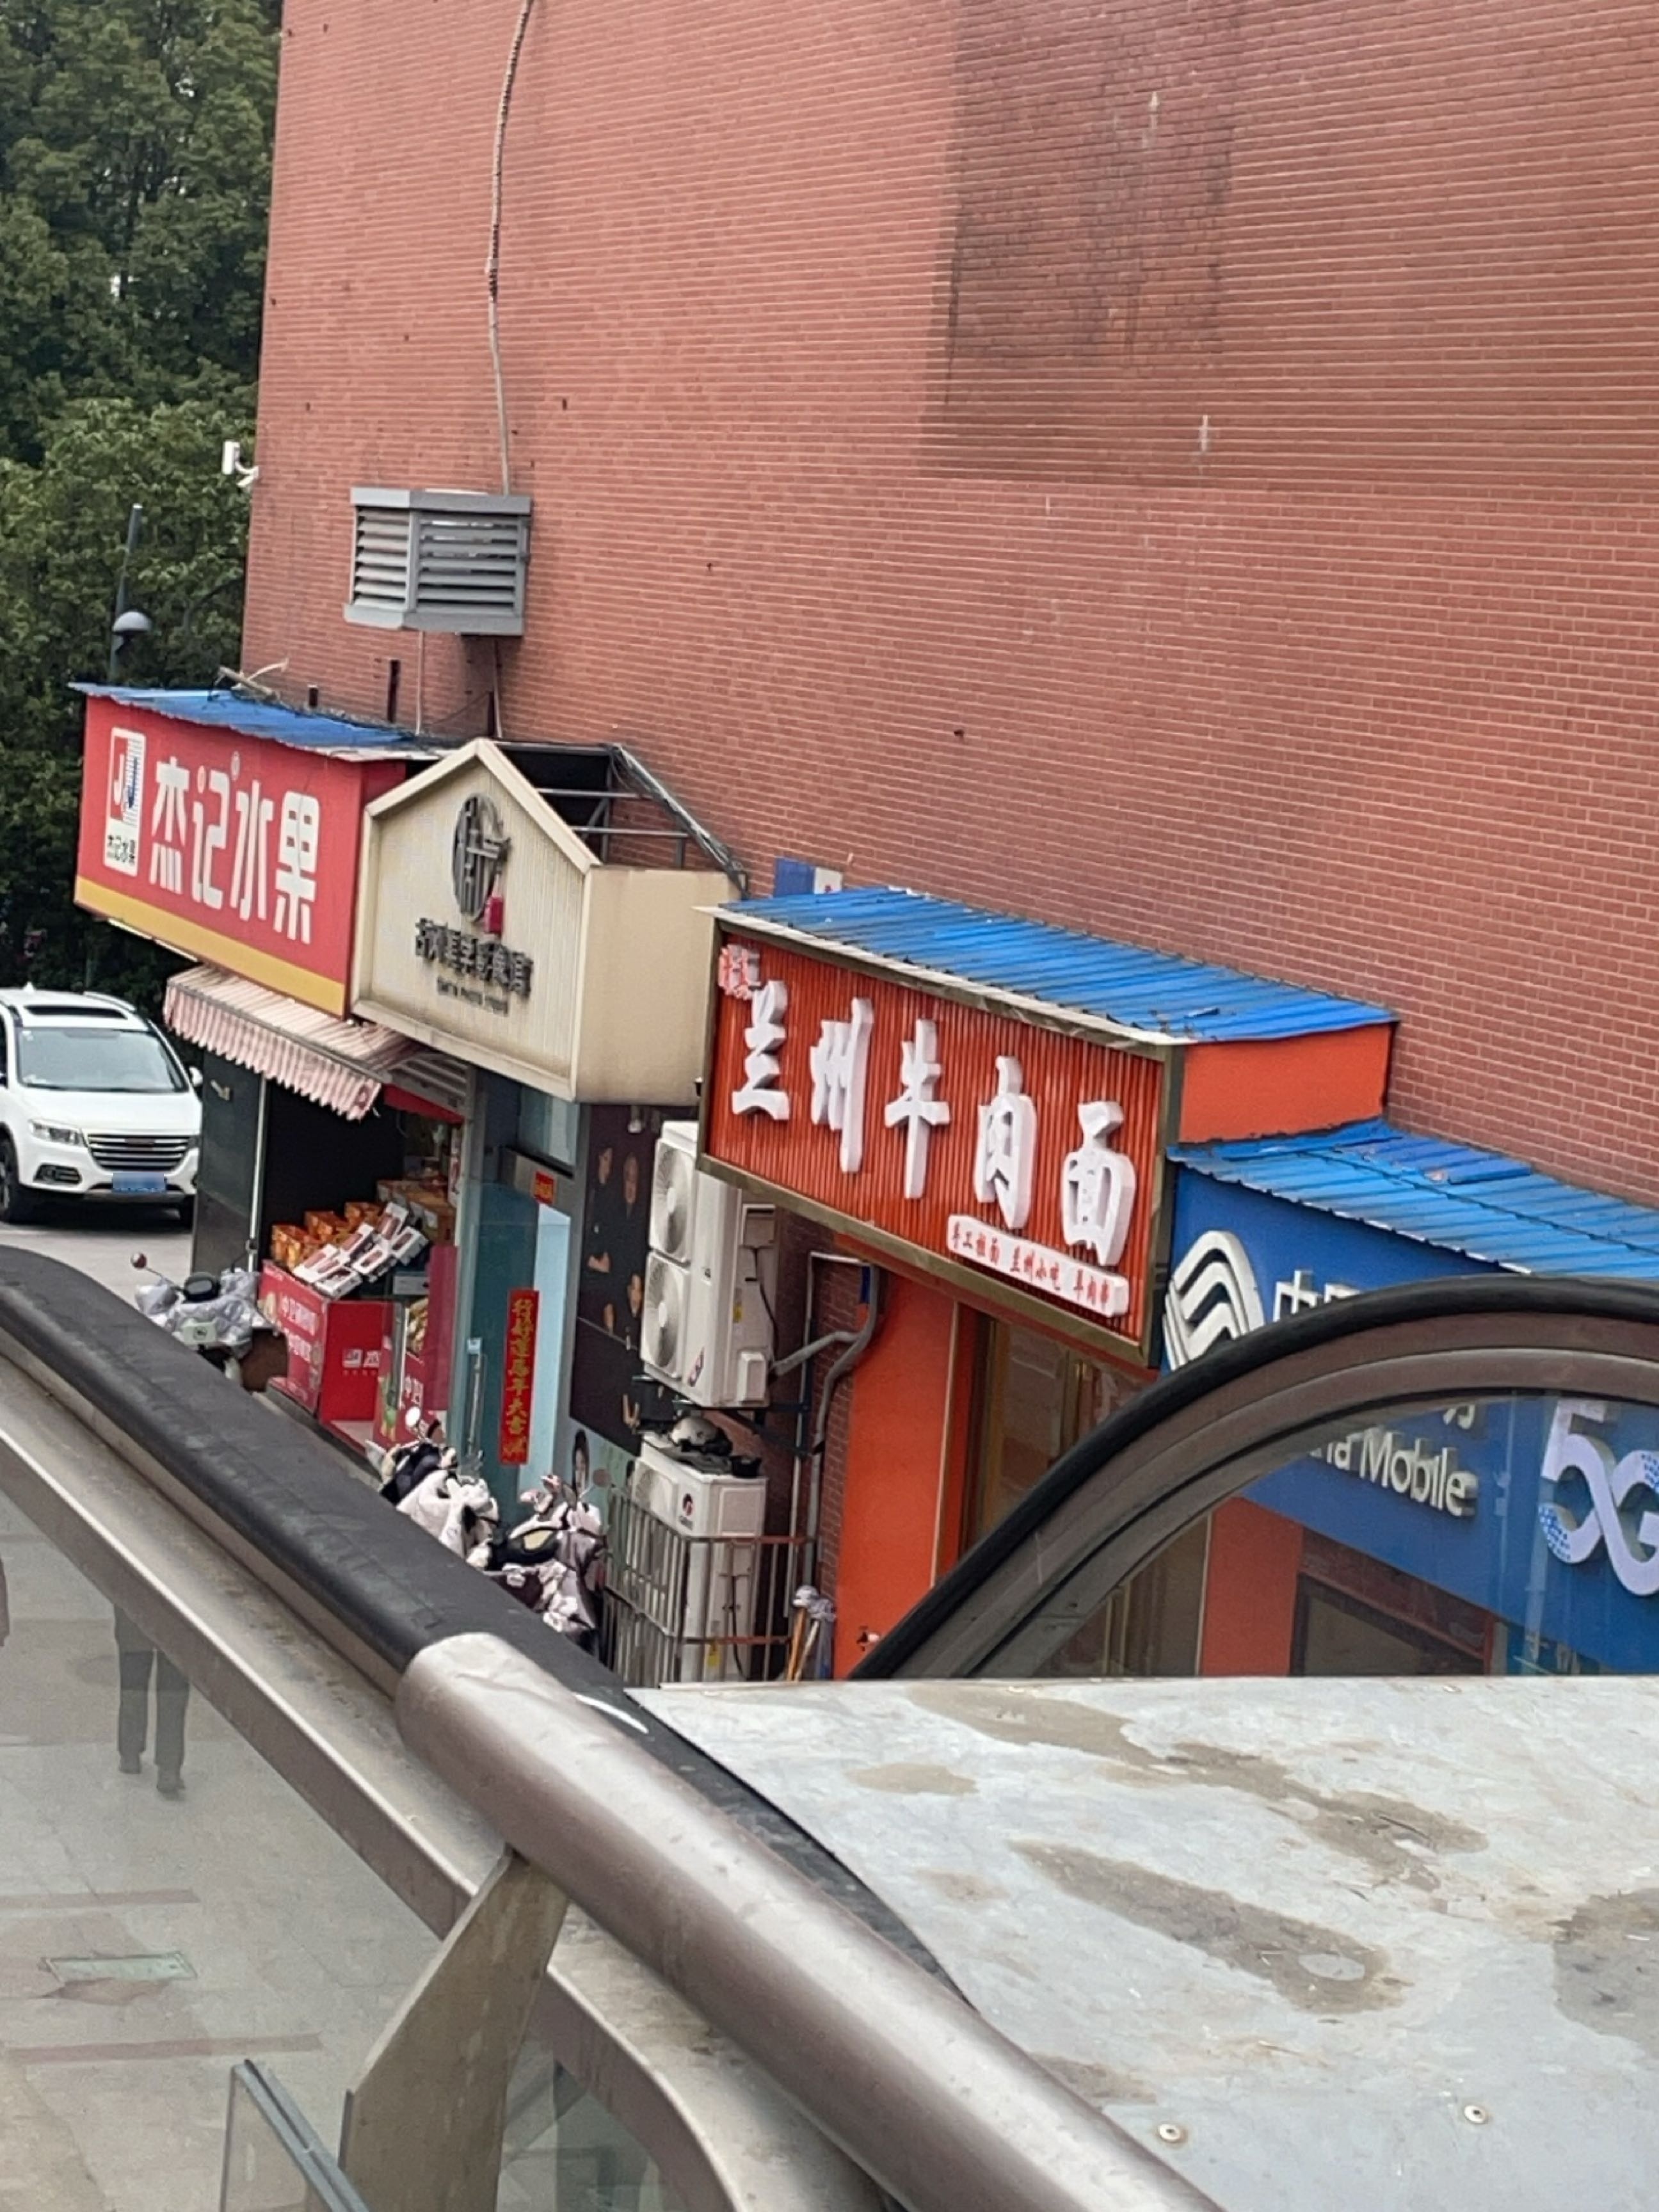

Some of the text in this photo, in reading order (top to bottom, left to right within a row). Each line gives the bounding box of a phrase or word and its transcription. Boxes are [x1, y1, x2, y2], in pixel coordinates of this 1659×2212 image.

[150, 755, 319, 945] 杰记水果
[732, 980, 1135, 1265] 兰州牛肉面
[1359, 1428, 1477, 1516] Mobile
[1539, 1400, 1659, 1596] 5G
